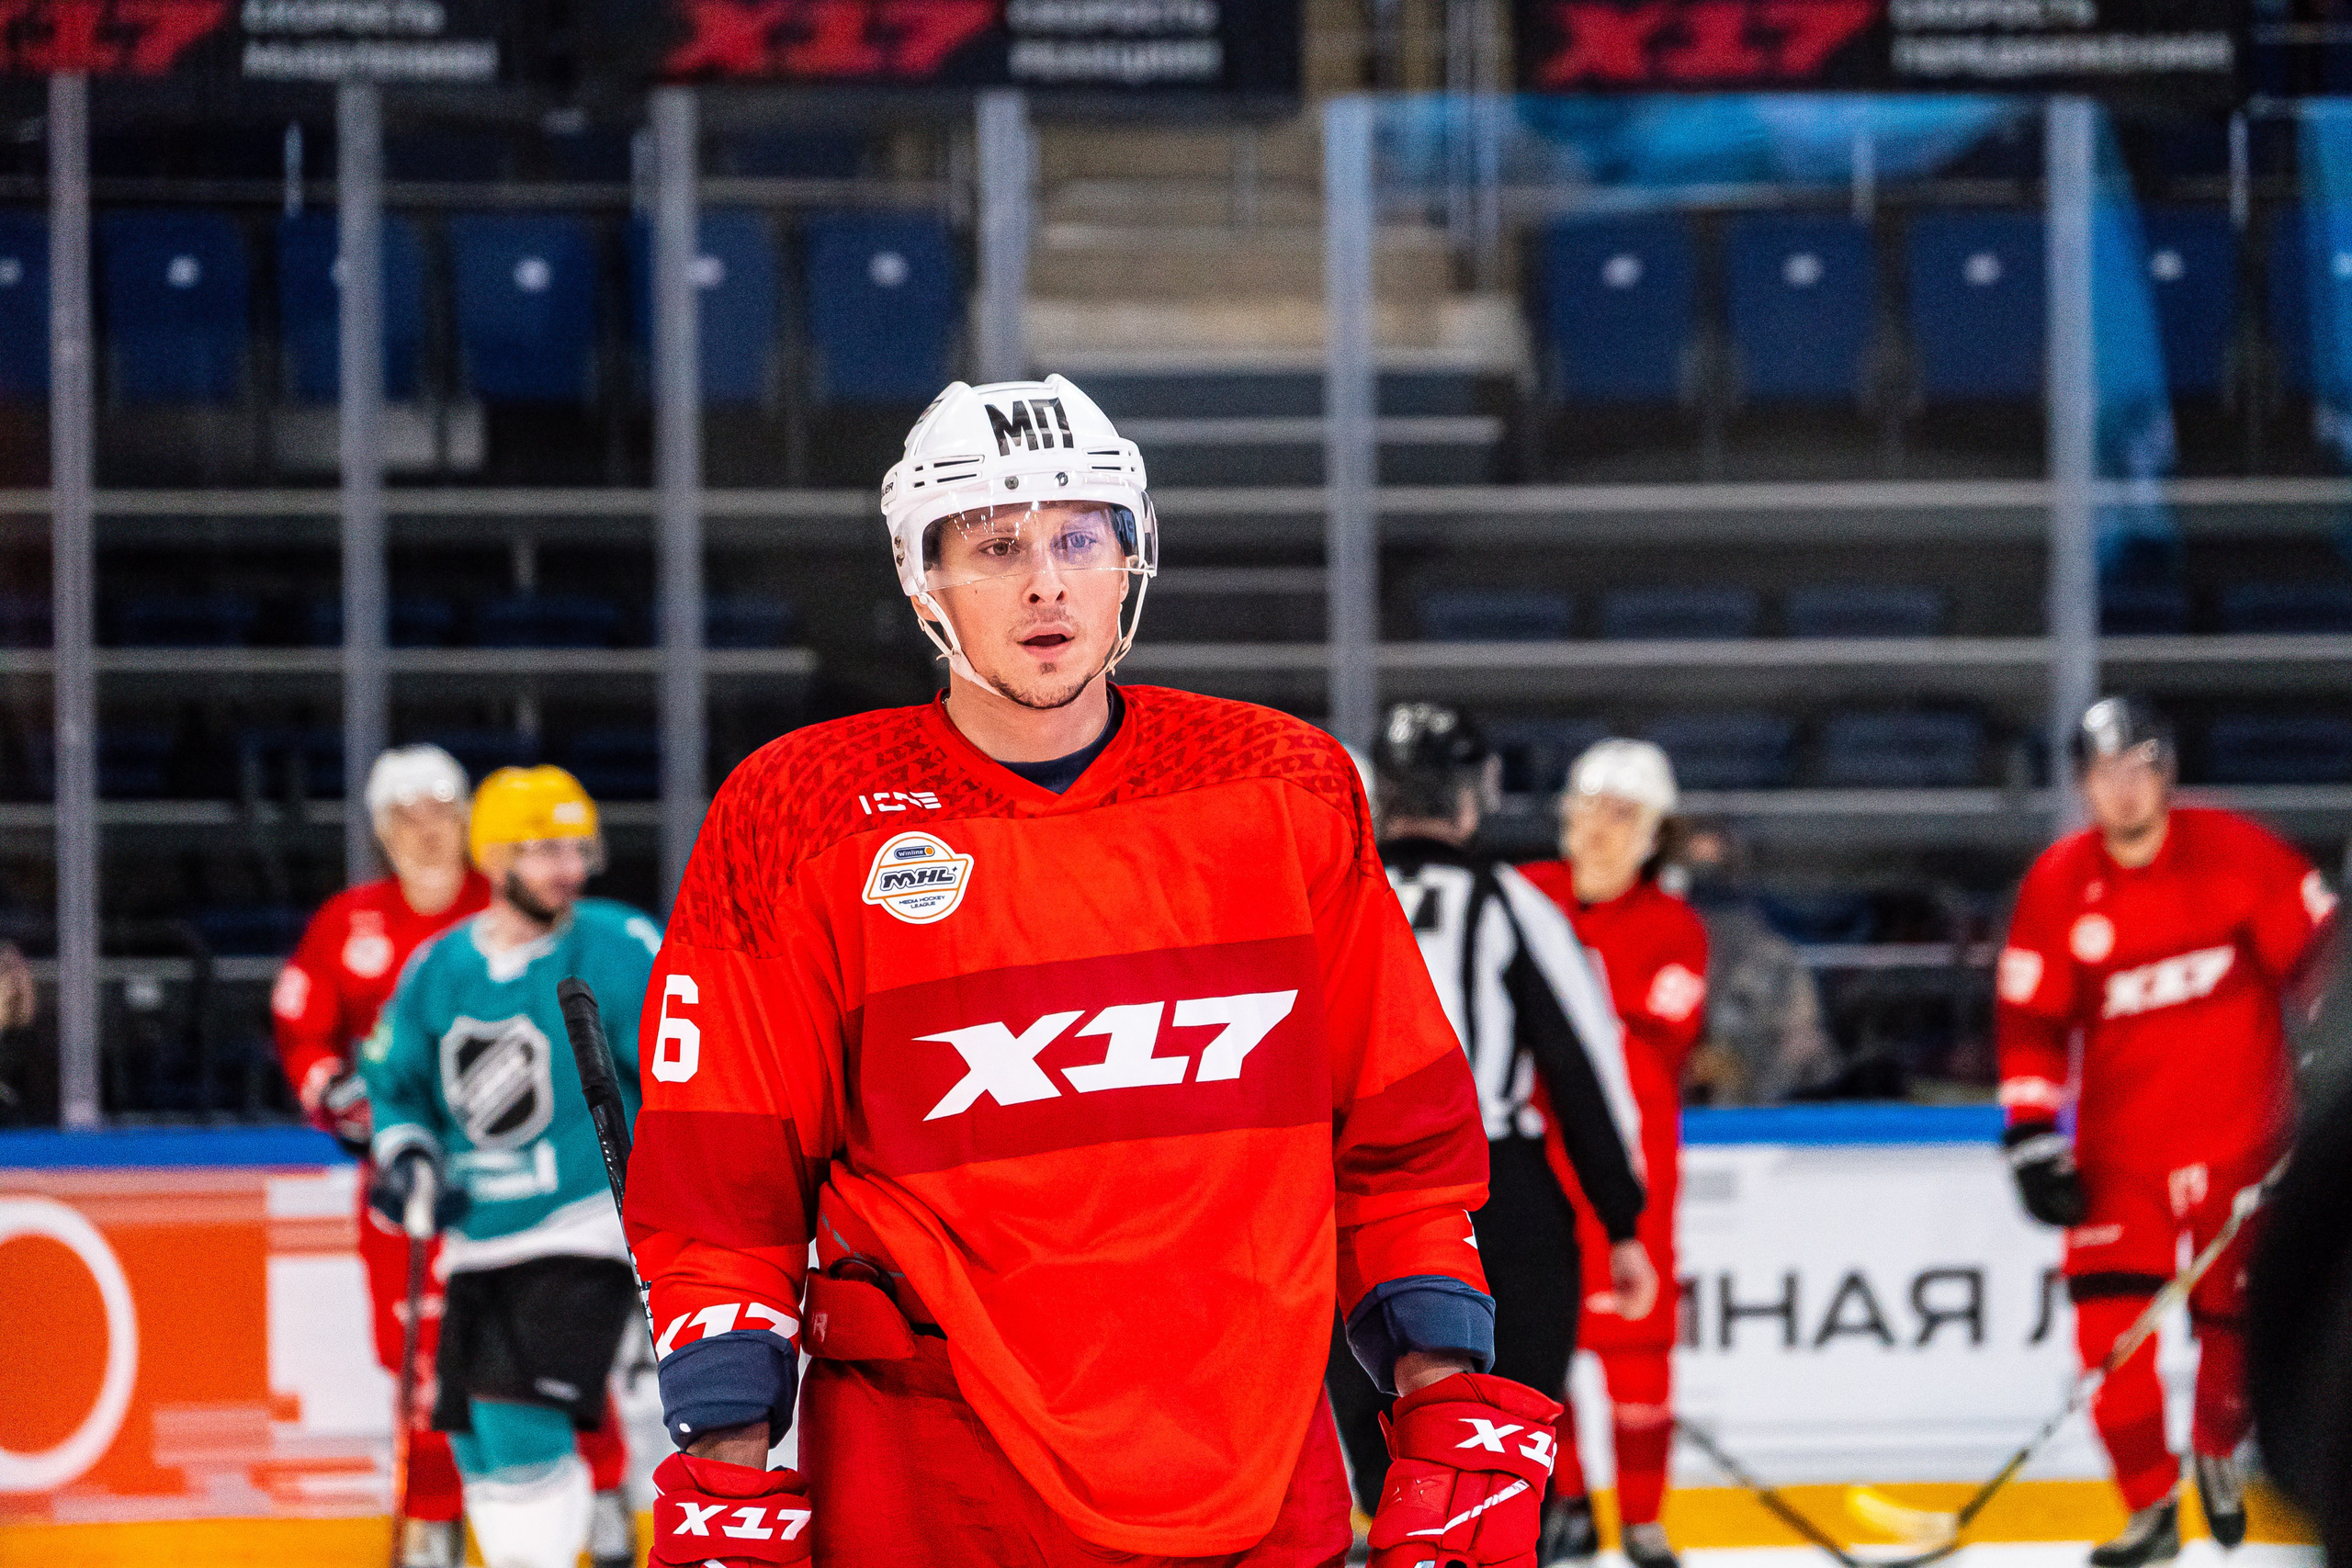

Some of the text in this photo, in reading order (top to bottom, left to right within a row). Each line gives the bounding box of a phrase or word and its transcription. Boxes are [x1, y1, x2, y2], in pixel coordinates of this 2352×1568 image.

[0, 0, 225, 73] 17
[984, 397, 1075, 457] МП
[882, 869, 954, 889] MHL
[911, 989, 1299, 1122] X17
[1455, 1417, 1557, 1476] X1
[673, 1502, 812, 1541] X17
